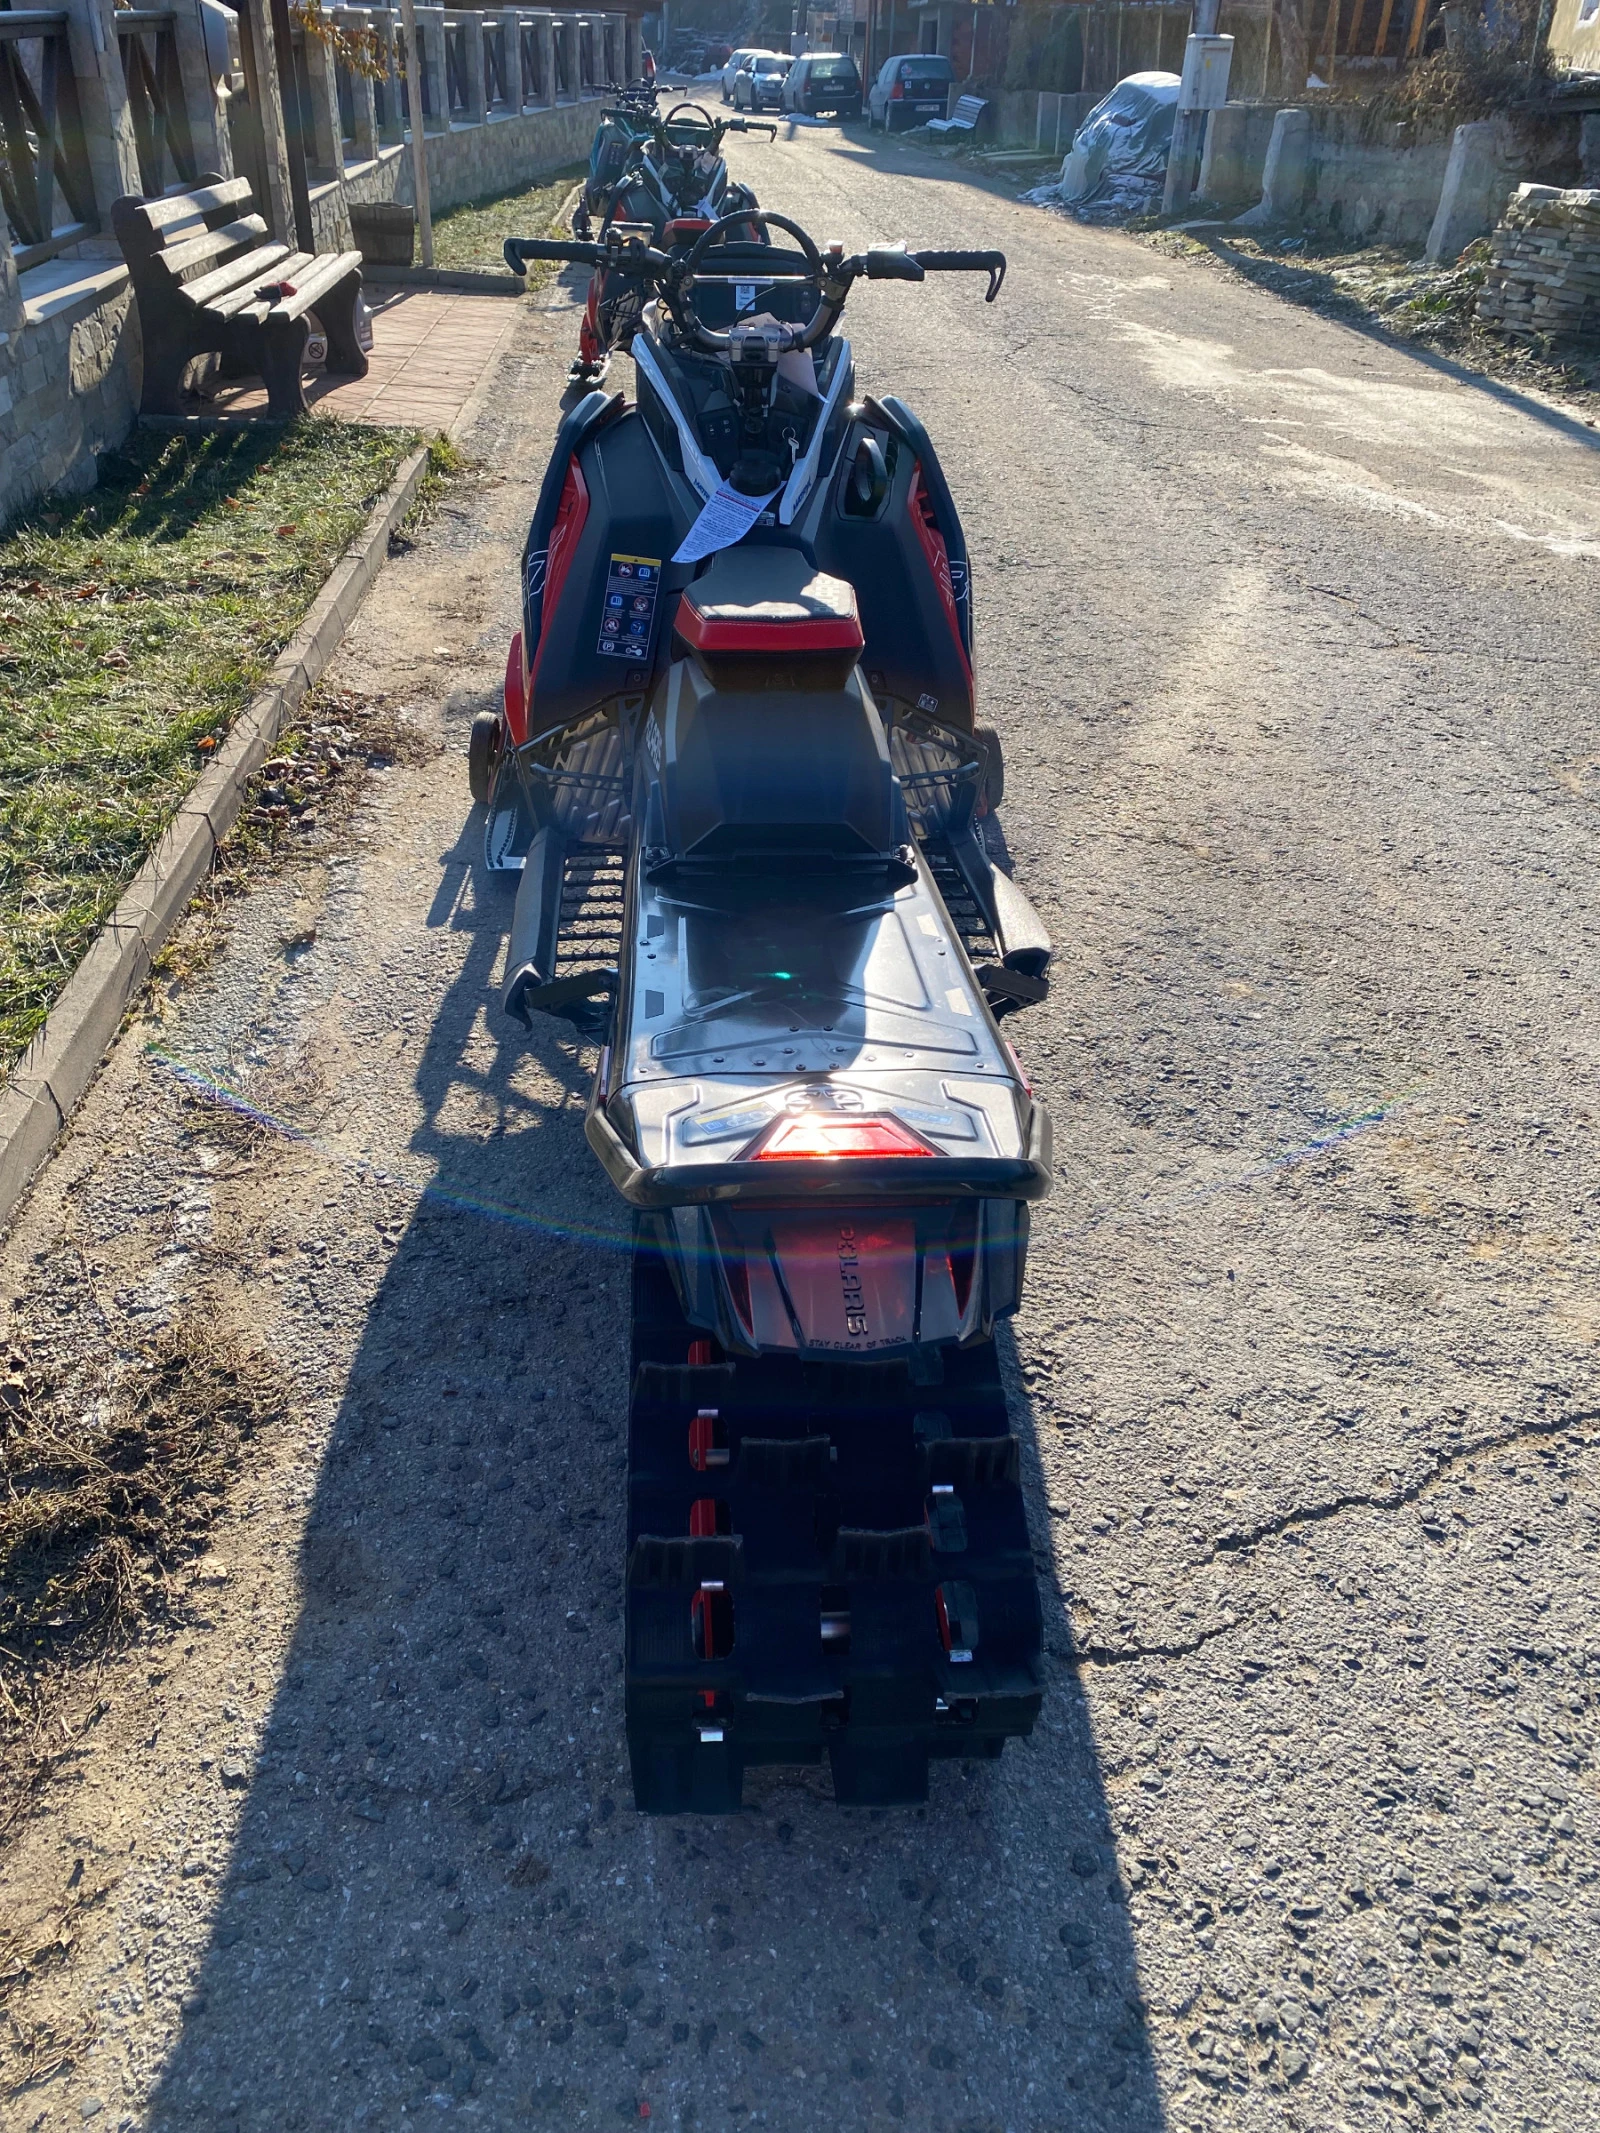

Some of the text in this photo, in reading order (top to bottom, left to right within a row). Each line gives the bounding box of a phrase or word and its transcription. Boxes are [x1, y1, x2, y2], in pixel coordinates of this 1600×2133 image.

[693, 478, 711, 501] MATR
[838, 1224, 868, 1336] POLARIS
[809, 1336, 907, 1351] STAY CLEAR OF TRACK
